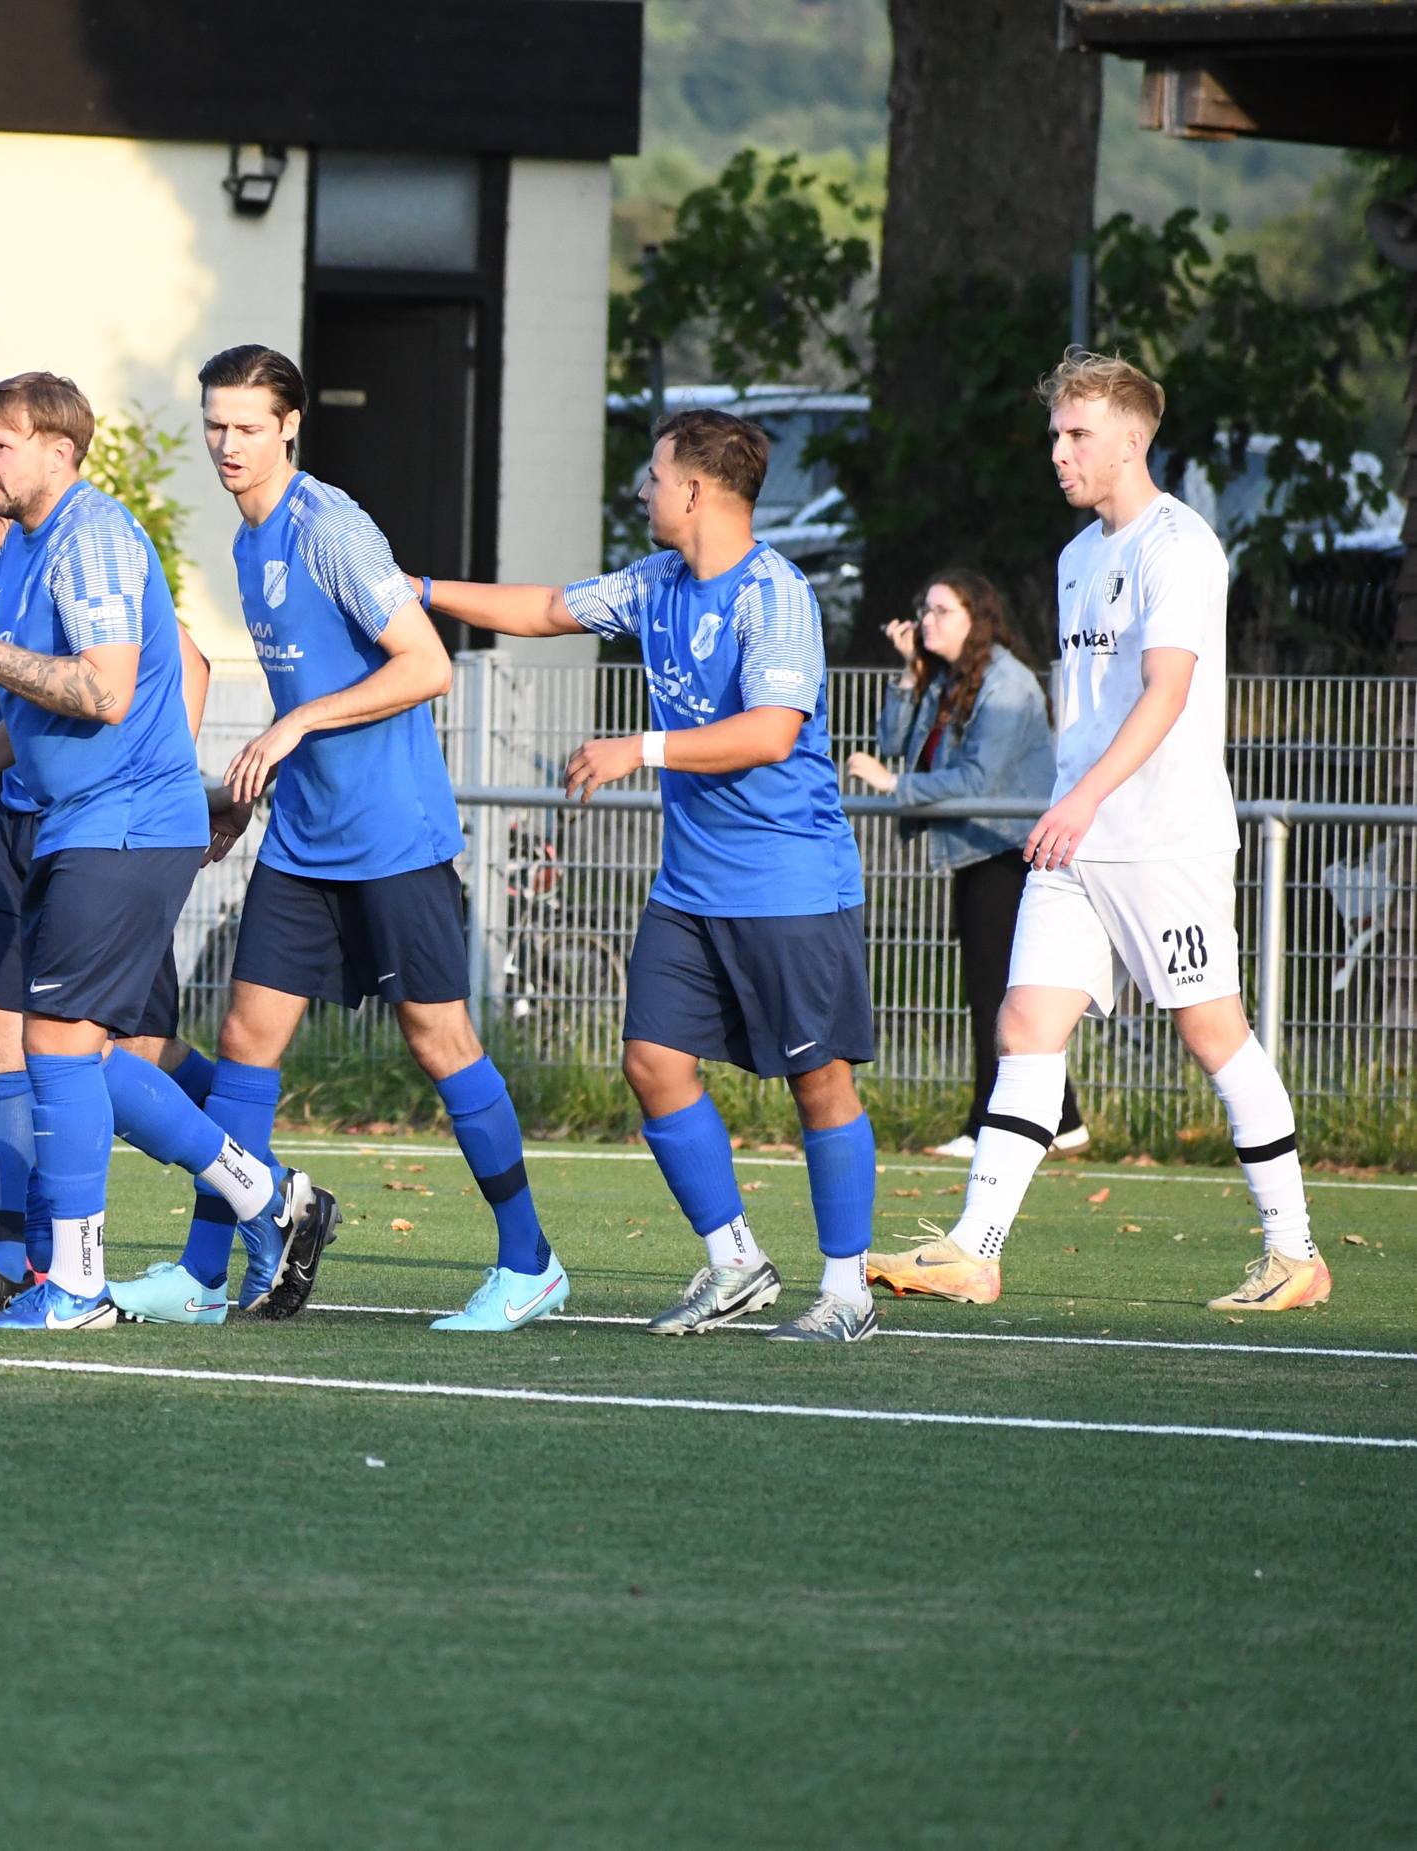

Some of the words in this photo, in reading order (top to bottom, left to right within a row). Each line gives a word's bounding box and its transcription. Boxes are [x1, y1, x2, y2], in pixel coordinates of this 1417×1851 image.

[765, 669, 804, 684] ERGO
[1162, 924, 1209, 975] 28
[1175, 973, 1204, 987] JAKO
